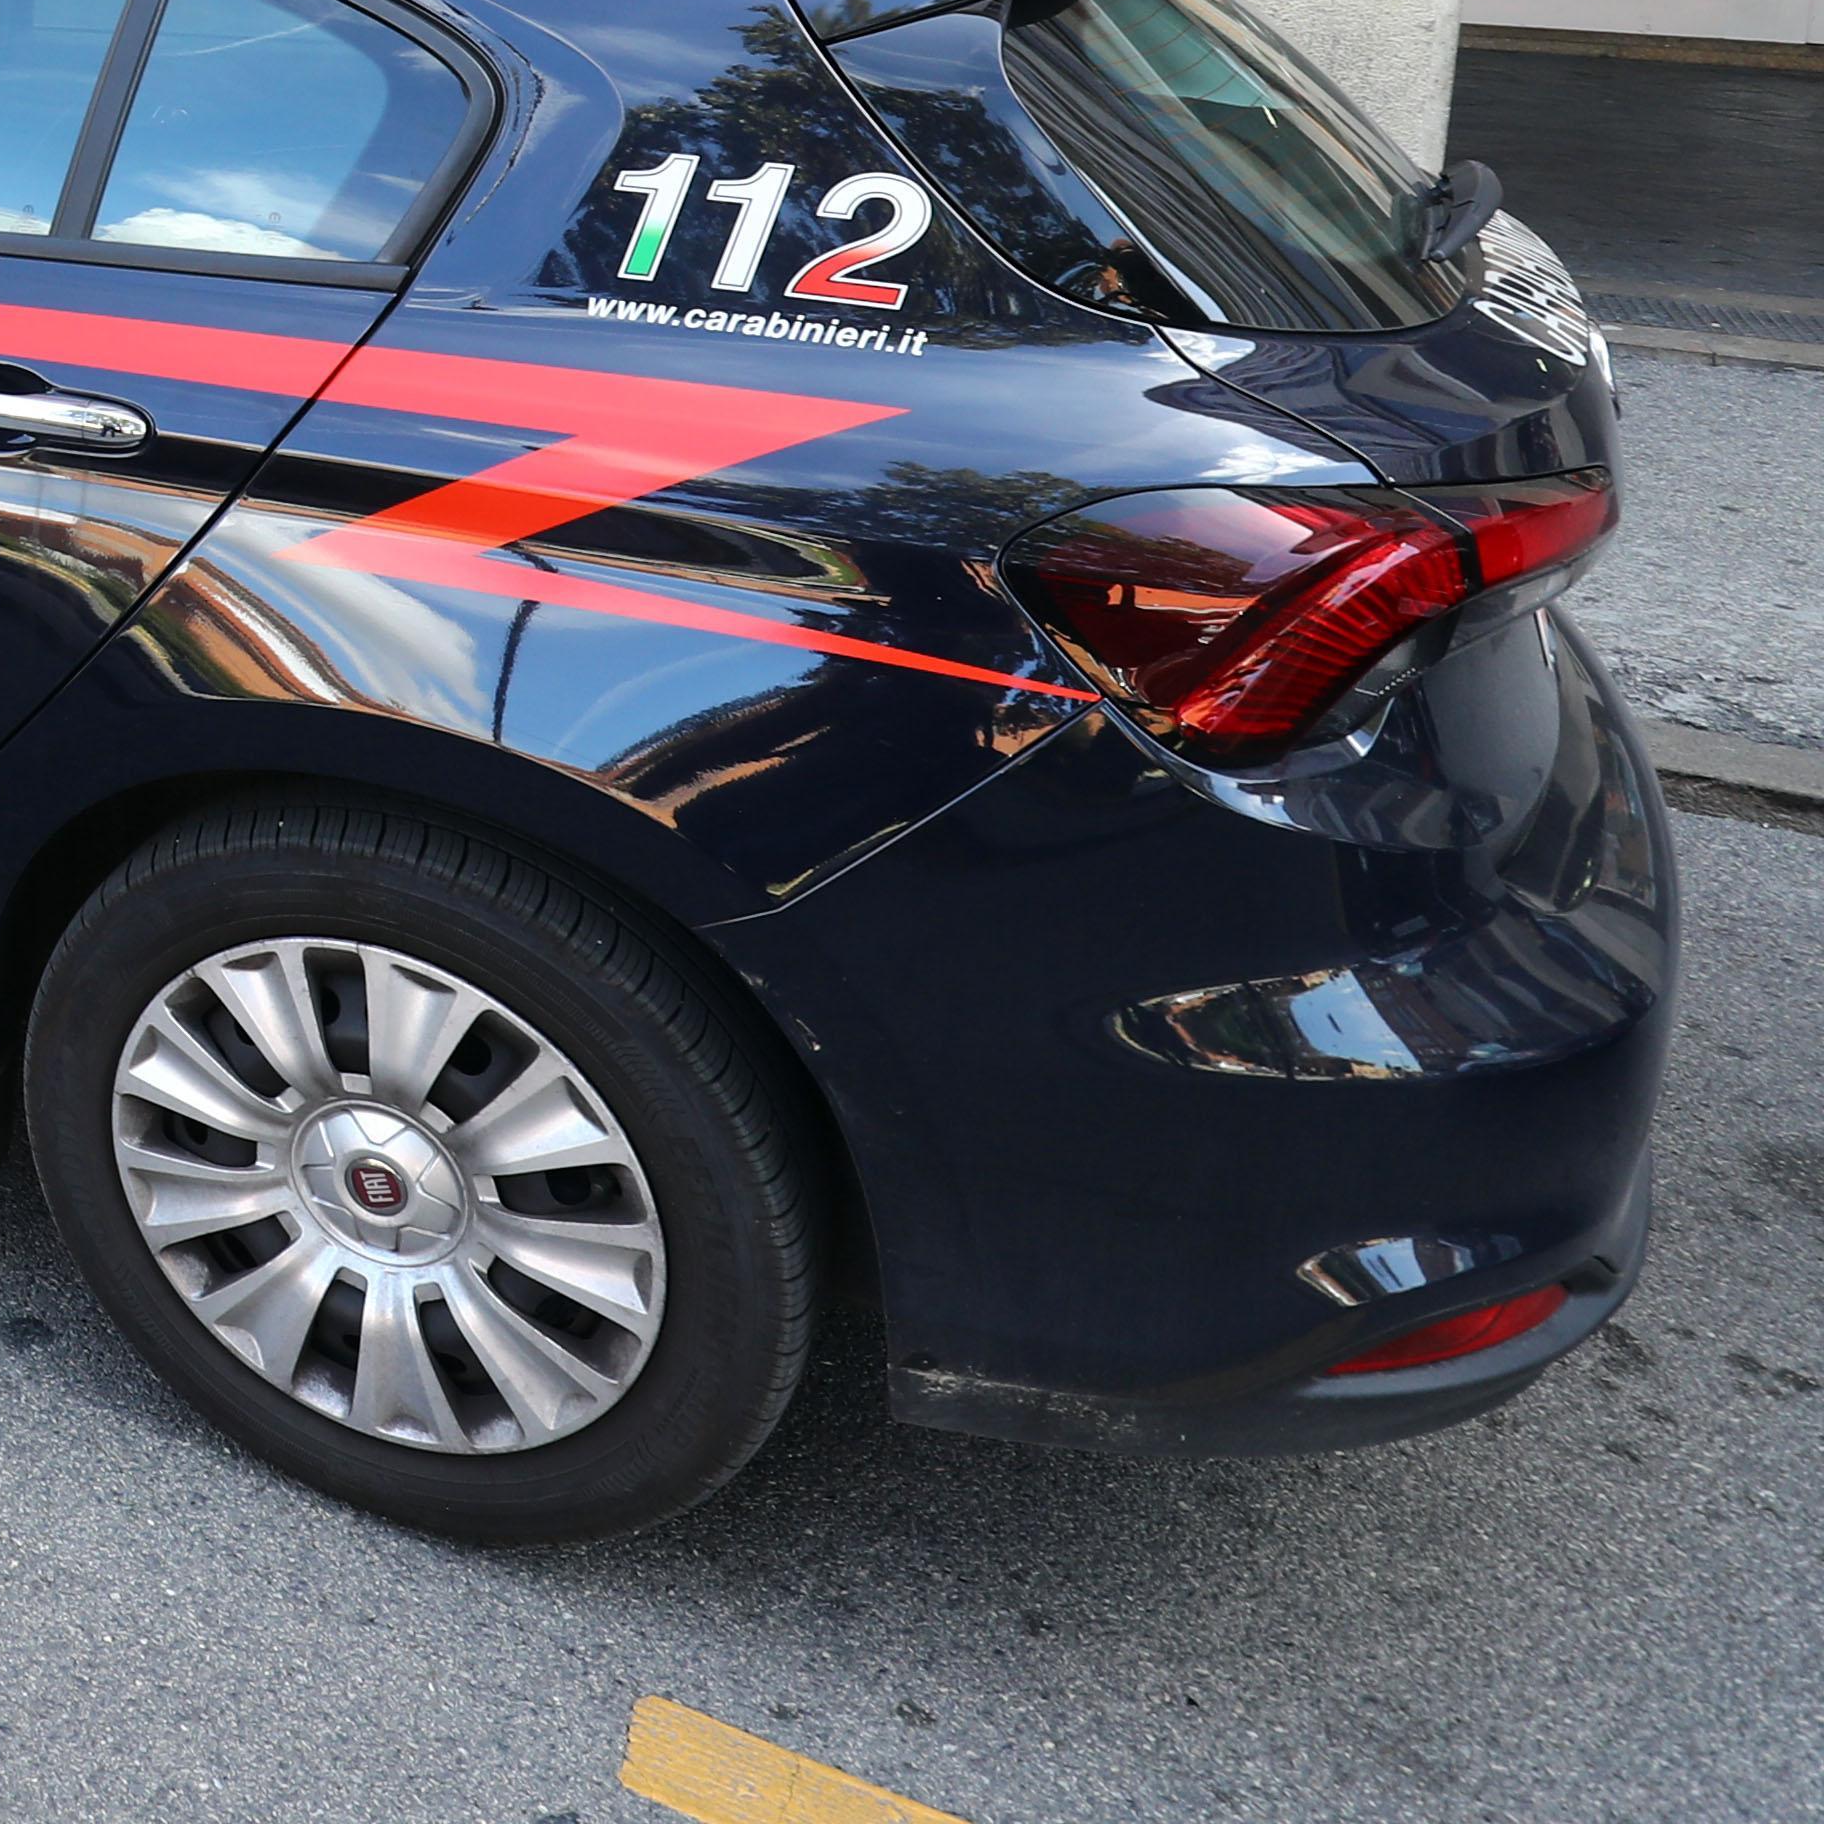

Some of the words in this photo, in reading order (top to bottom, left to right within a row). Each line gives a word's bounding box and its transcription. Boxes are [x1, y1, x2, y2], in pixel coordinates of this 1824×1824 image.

[612, 152, 933, 311] 112
[587, 295, 929, 357] www.carabinieri.it
[359, 1170, 395, 1203] FIAT
